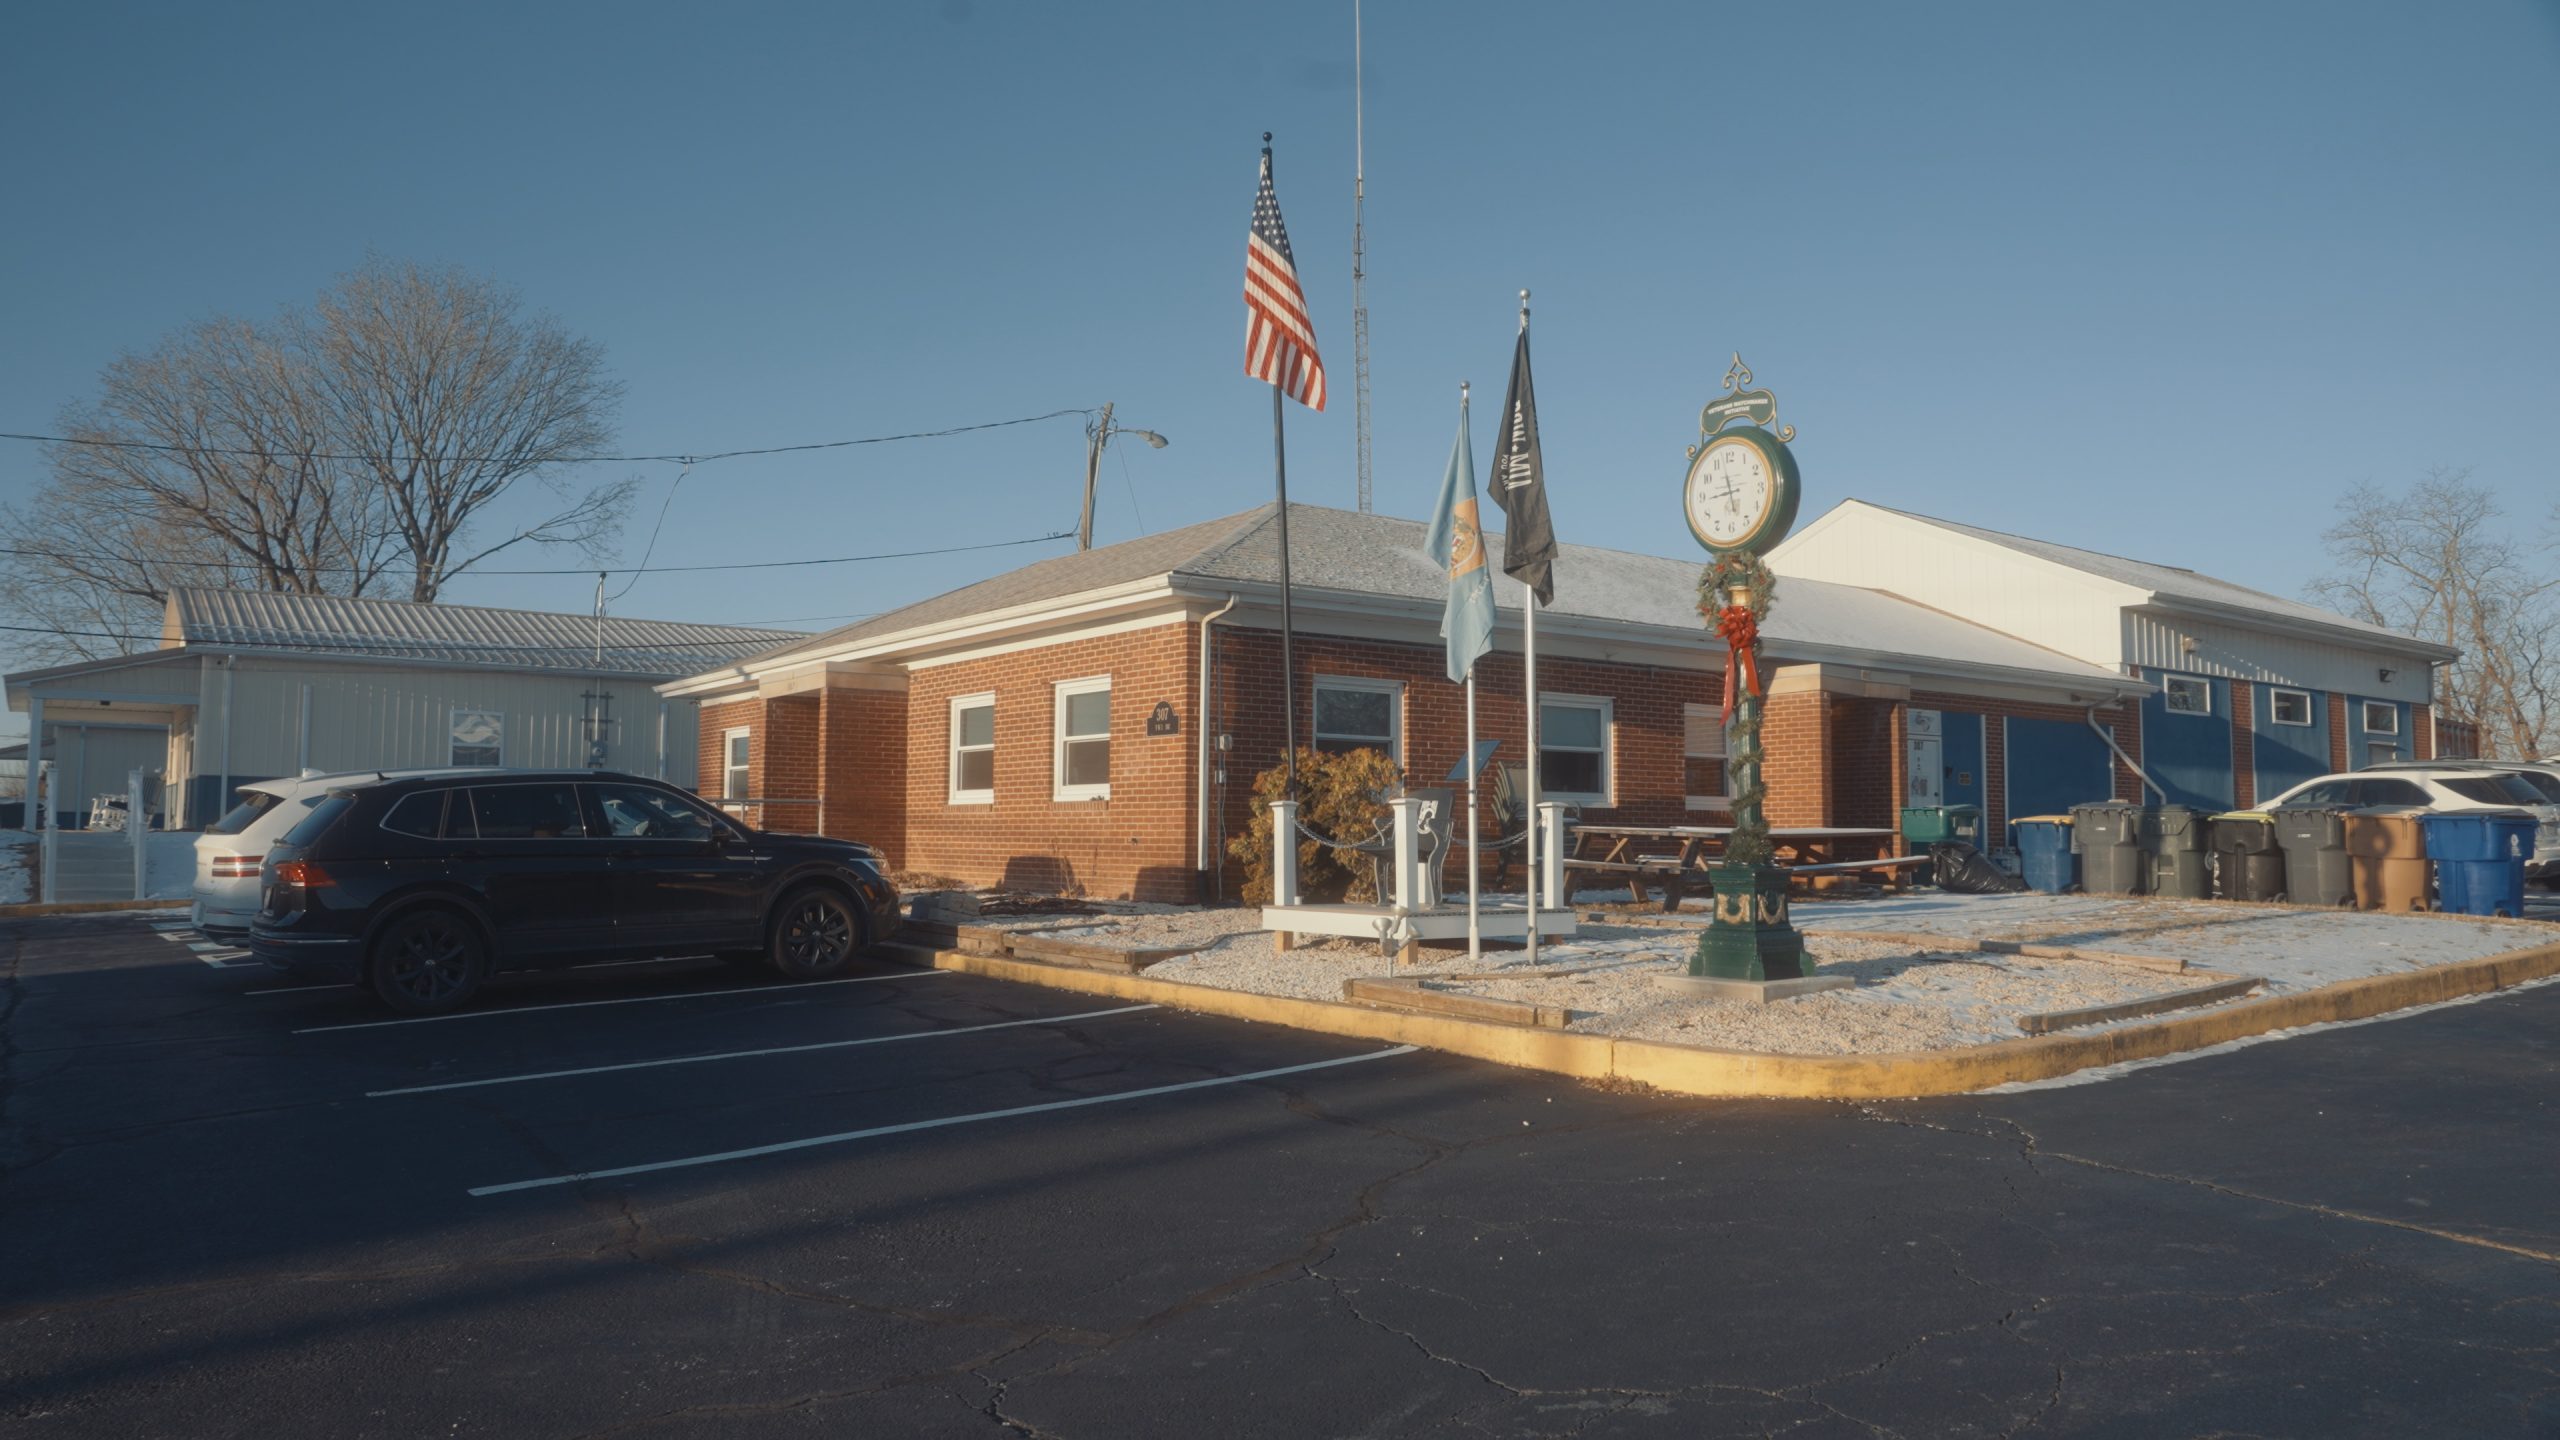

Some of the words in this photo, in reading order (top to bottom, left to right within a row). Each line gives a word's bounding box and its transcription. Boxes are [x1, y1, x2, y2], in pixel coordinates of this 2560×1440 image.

[1725, 451, 1735, 464] 12
[1742, 453, 1747, 464] 1
[1713, 458, 1720, 471] 11
[1752, 464, 1759, 476] 2
[1703, 473, 1712, 485] 10
[1757, 481, 1764, 494] 3
[1698, 492, 1706, 503] 9
[1728, 521, 1735, 533] 6
[1156, 707, 1169, 721] 307
